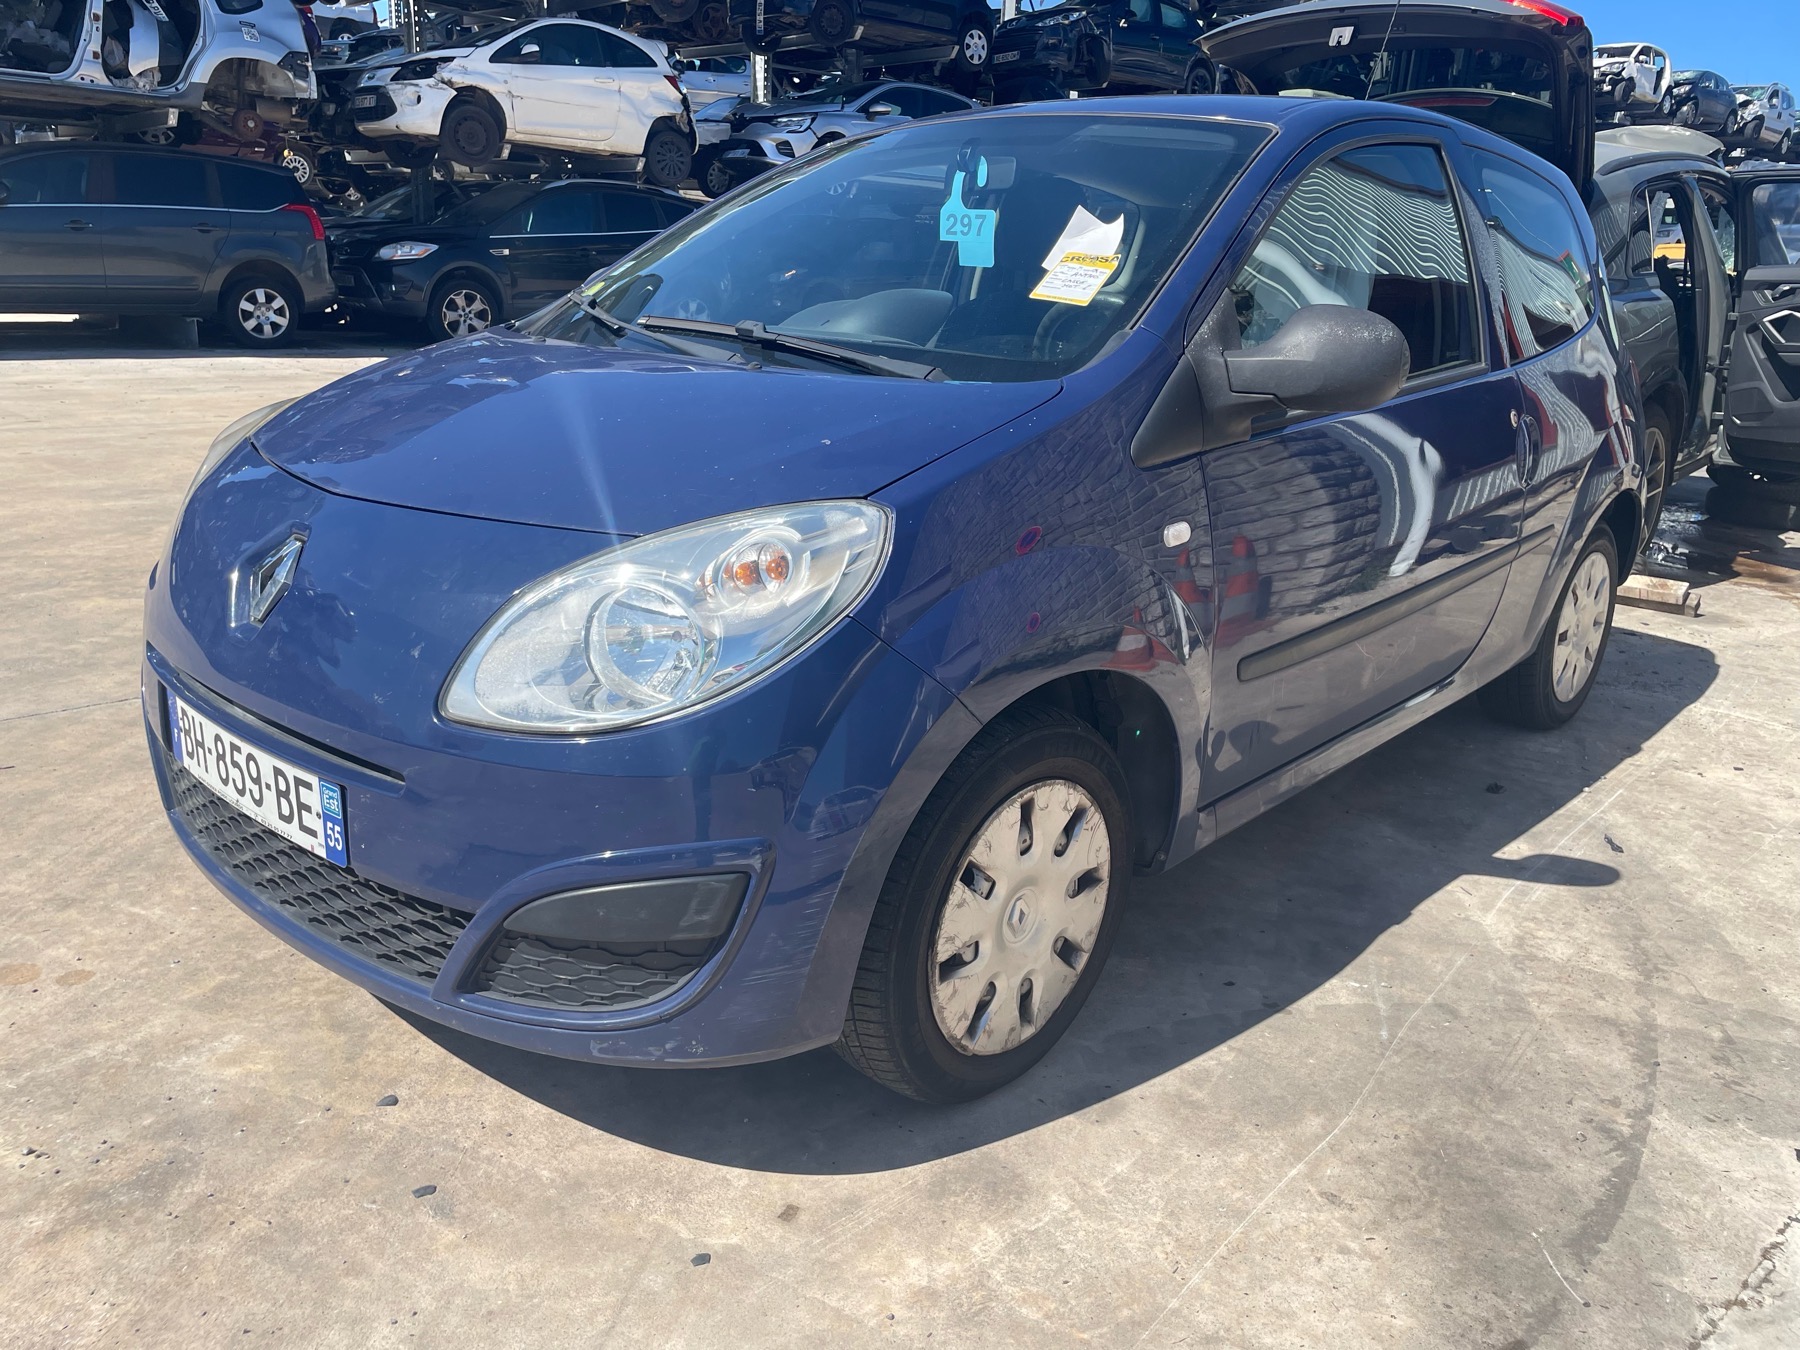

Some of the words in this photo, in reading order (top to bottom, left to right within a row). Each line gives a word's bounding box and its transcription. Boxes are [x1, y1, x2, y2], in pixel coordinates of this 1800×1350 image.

[945, 213, 987, 236] 297
[174, 727, 179, 742] F
[180, 705, 318, 840] BH-859-BE
[323, 786, 338, 799] Grand
[324, 795, 339, 812] Est
[326, 821, 343, 851] 55
